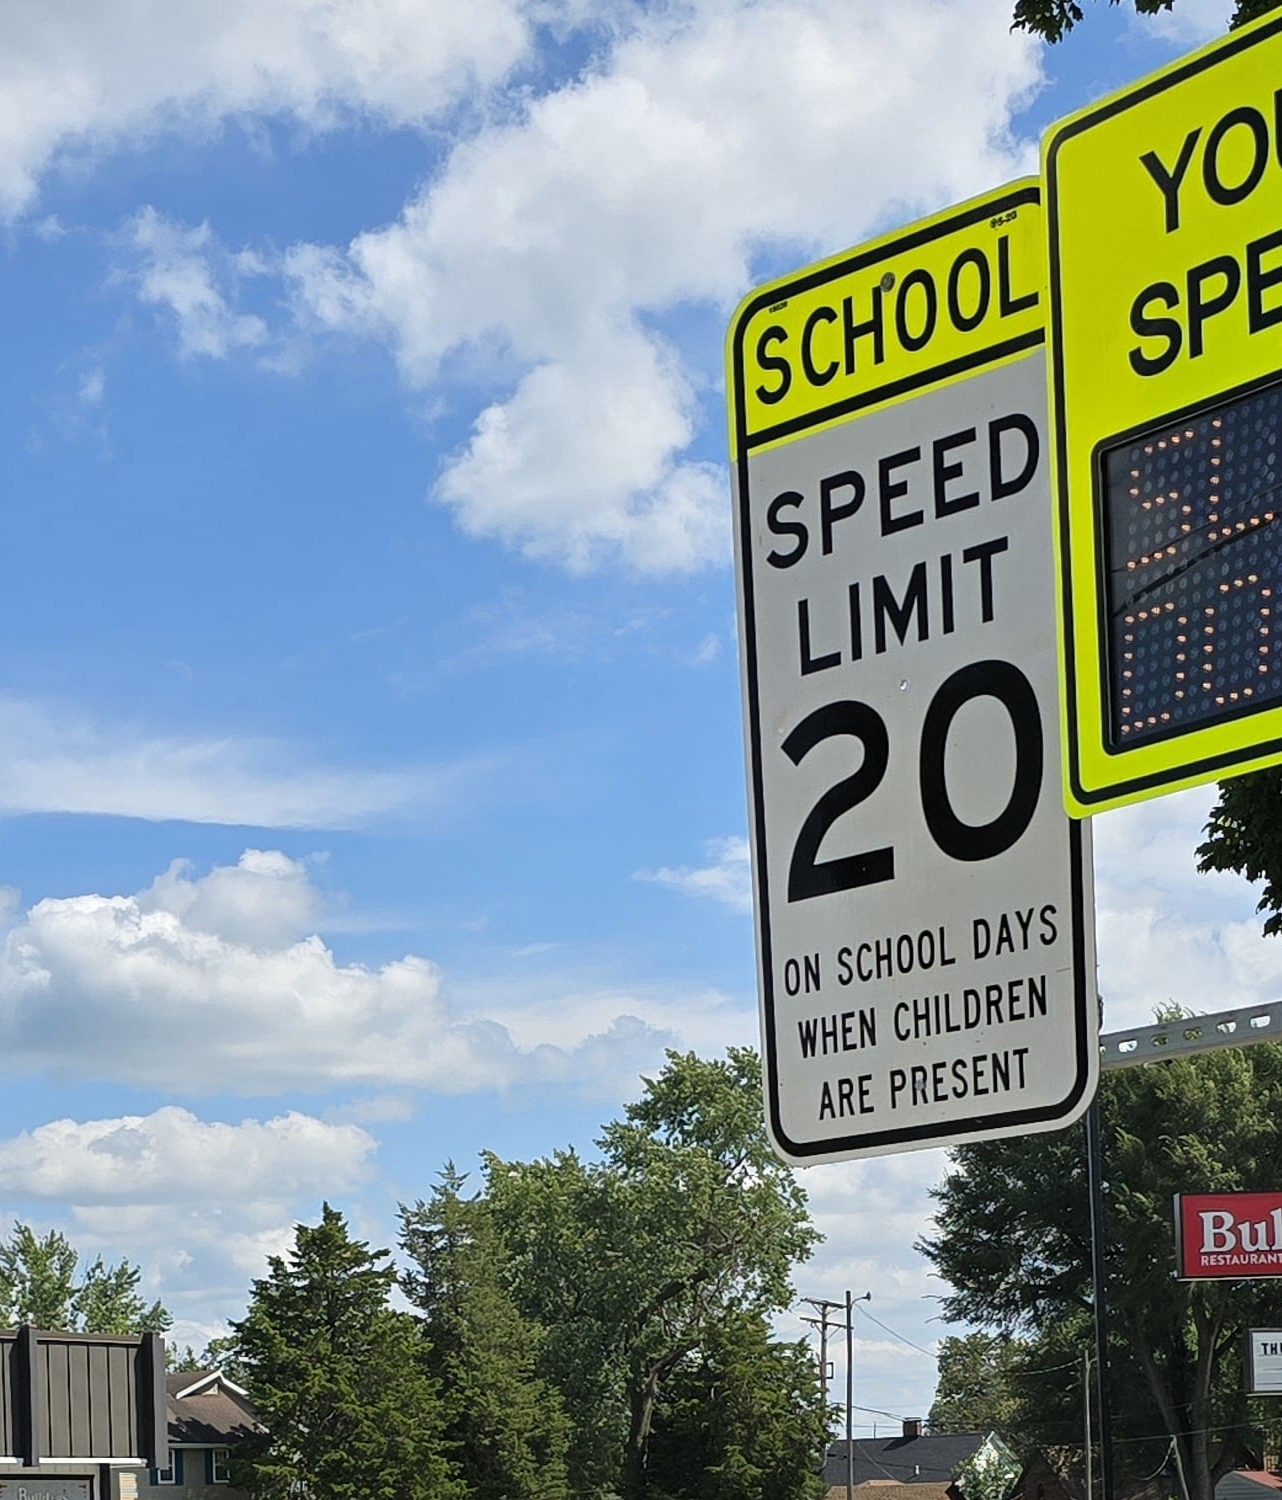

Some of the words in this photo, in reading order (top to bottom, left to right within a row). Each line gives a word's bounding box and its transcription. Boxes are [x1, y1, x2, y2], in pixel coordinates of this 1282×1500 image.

[755, 235, 1039, 405] SCHOOL
[766, 413, 1040, 569] SPEED
[798, 535, 1009, 677] LIMIT
[780, 659, 1044, 904] 20
[784, 953, 821, 997] ON
[837, 926, 956, 987] SCHOOL
[973, 904, 1058, 960] DAYS
[798, 1007, 877, 1059] WHEN
[894, 975, 1047, 1042] CHILDREN
[819, 1074, 875, 1121] ARE
[889, 1048, 1029, 1110] PRESENT
